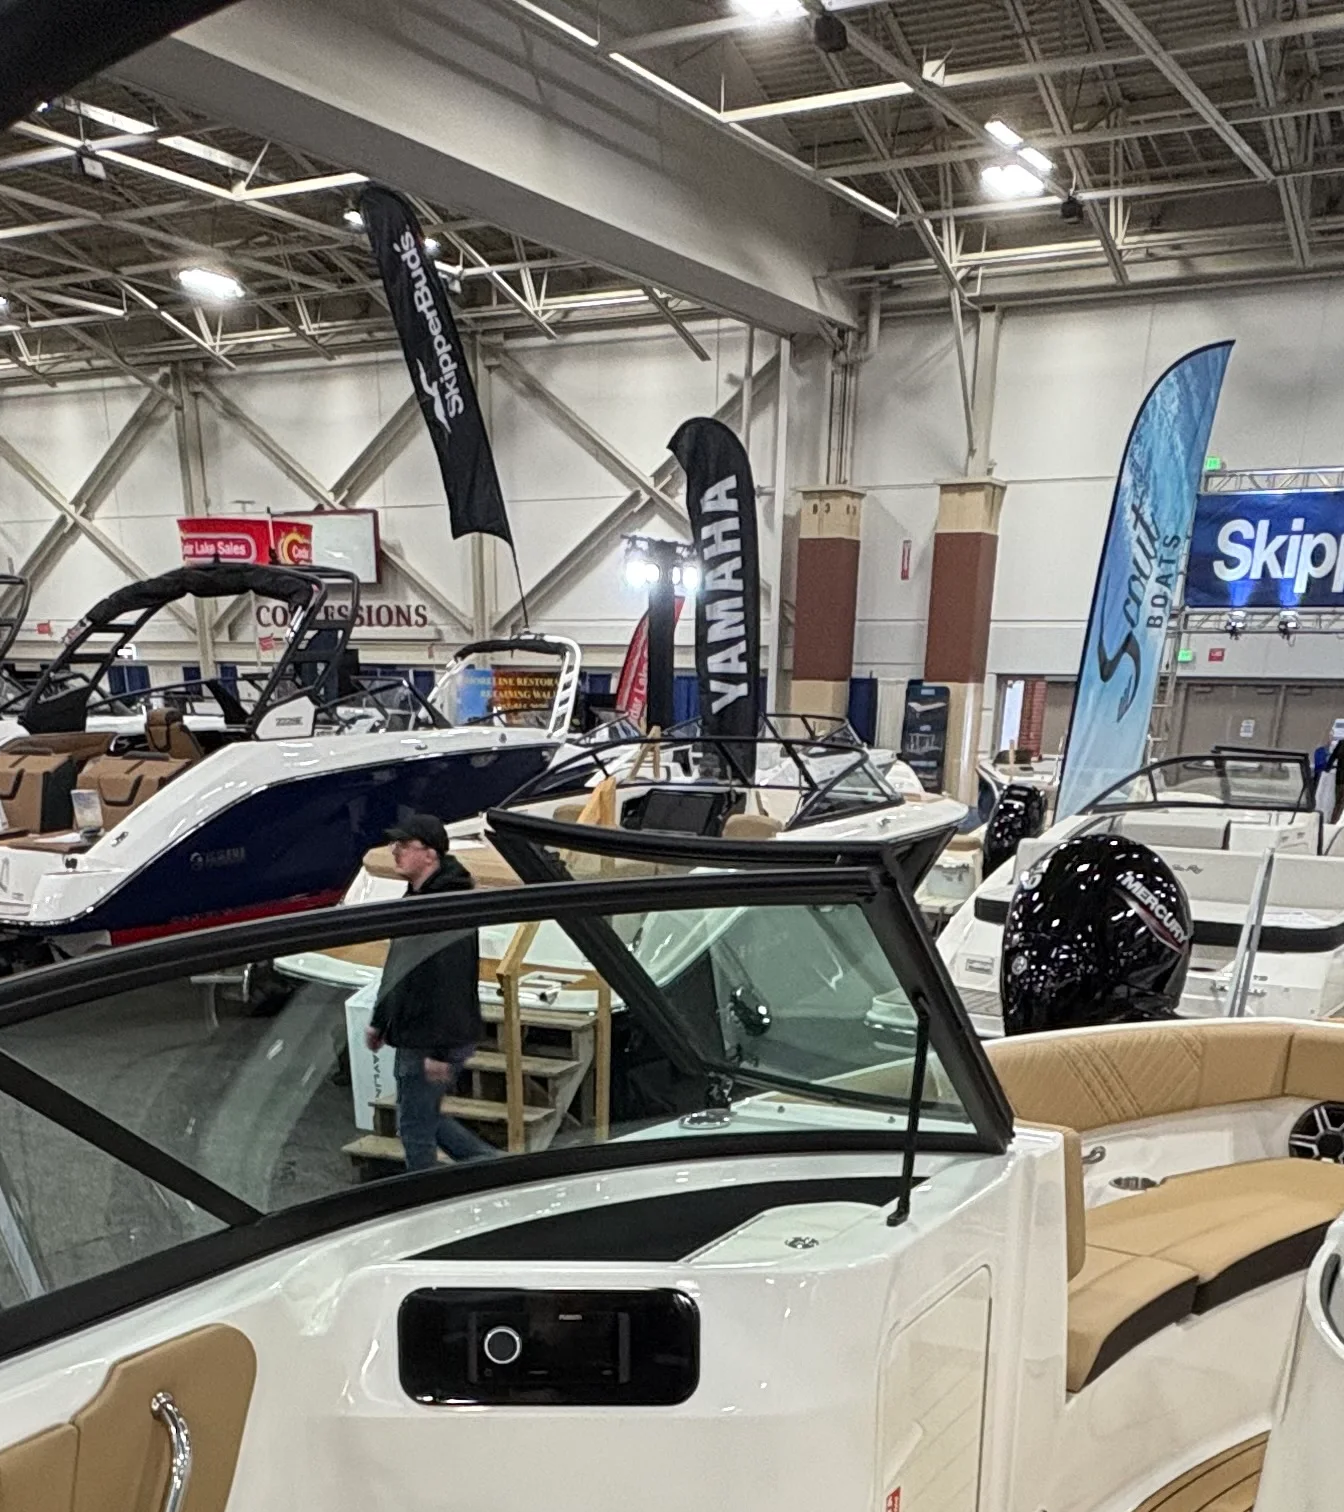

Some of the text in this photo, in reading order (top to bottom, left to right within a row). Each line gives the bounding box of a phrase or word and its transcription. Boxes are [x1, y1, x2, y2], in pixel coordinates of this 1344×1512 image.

[194, 540, 216, 555] Lake
[216, 539, 247, 556] Sales
[1146, 533, 1182, 630] BOATS
[700, 474, 749, 715] YAMAHA
[1120, 874, 1188, 944] MERCURY
